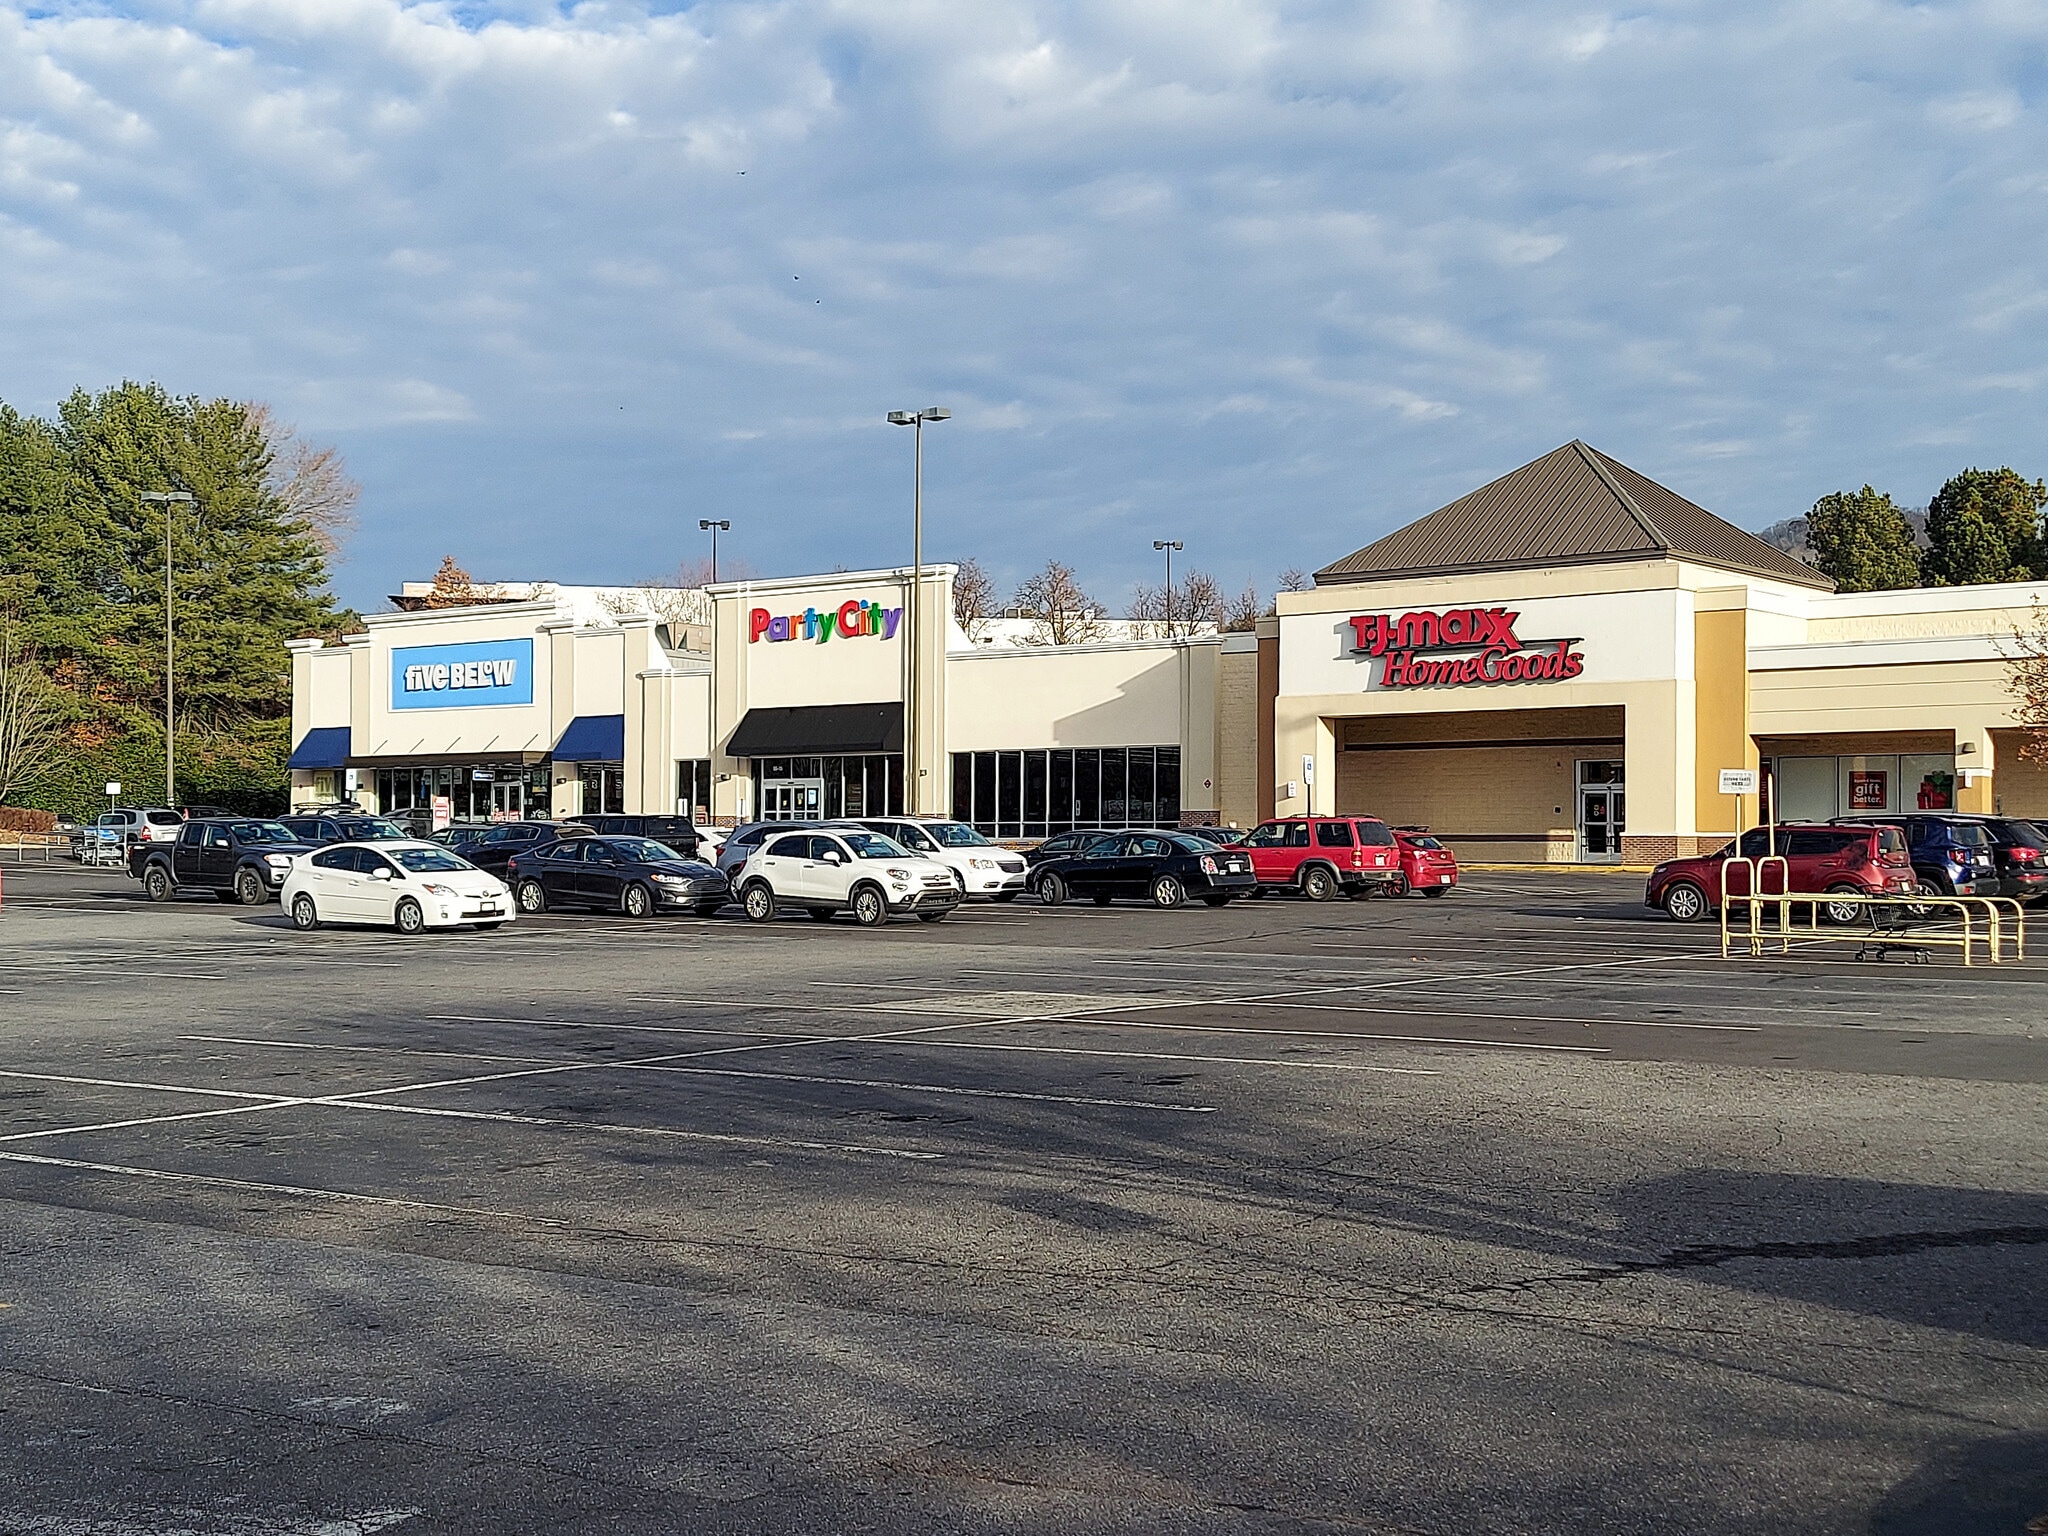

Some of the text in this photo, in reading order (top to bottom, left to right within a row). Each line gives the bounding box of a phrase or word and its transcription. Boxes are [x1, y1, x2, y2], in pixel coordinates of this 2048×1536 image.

[750, 599, 903, 644] Party City
[450, 659, 516, 689] BELOW
[1380, 641, 1584, 687] HomeGoods
[1855, 784, 1880, 797] gift
